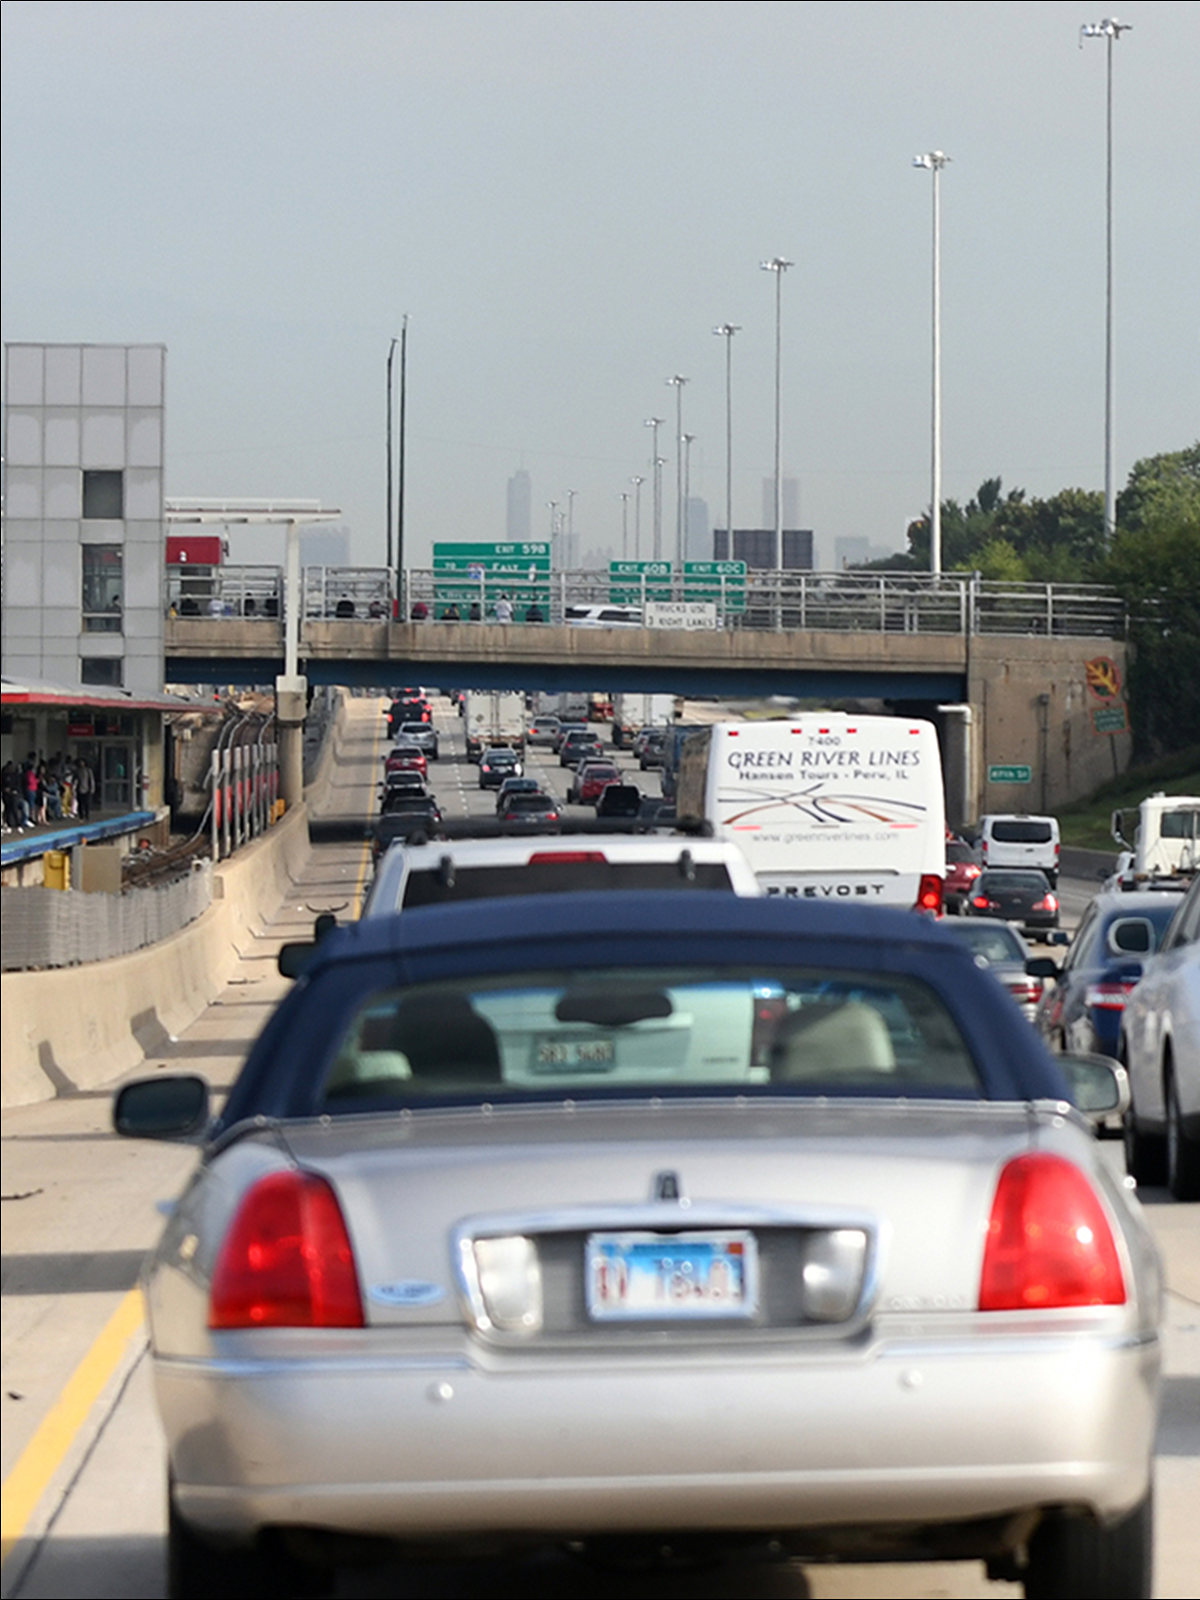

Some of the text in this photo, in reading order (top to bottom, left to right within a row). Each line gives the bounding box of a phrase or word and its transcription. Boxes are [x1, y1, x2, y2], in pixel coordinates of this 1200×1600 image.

[495, 545, 515, 554] EXIT
[618, 564, 639, 573] EXIT
[692, 563, 741, 574] EXIT 60C
[655, 604, 707, 614] TRUCKS USE
[659, 617, 683, 626] RIGHT
[687, 618, 713, 628] LANES
[808, 737, 841, 746] 7400
[728, 750, 921, 770] GREEN RIVER LINES
[739, 770, 795, 781] Hansen
[800, 770, 839, 780] Tours
[896, 769, 909, 780] IL
[766, 884, 884, 898] PREVOST
